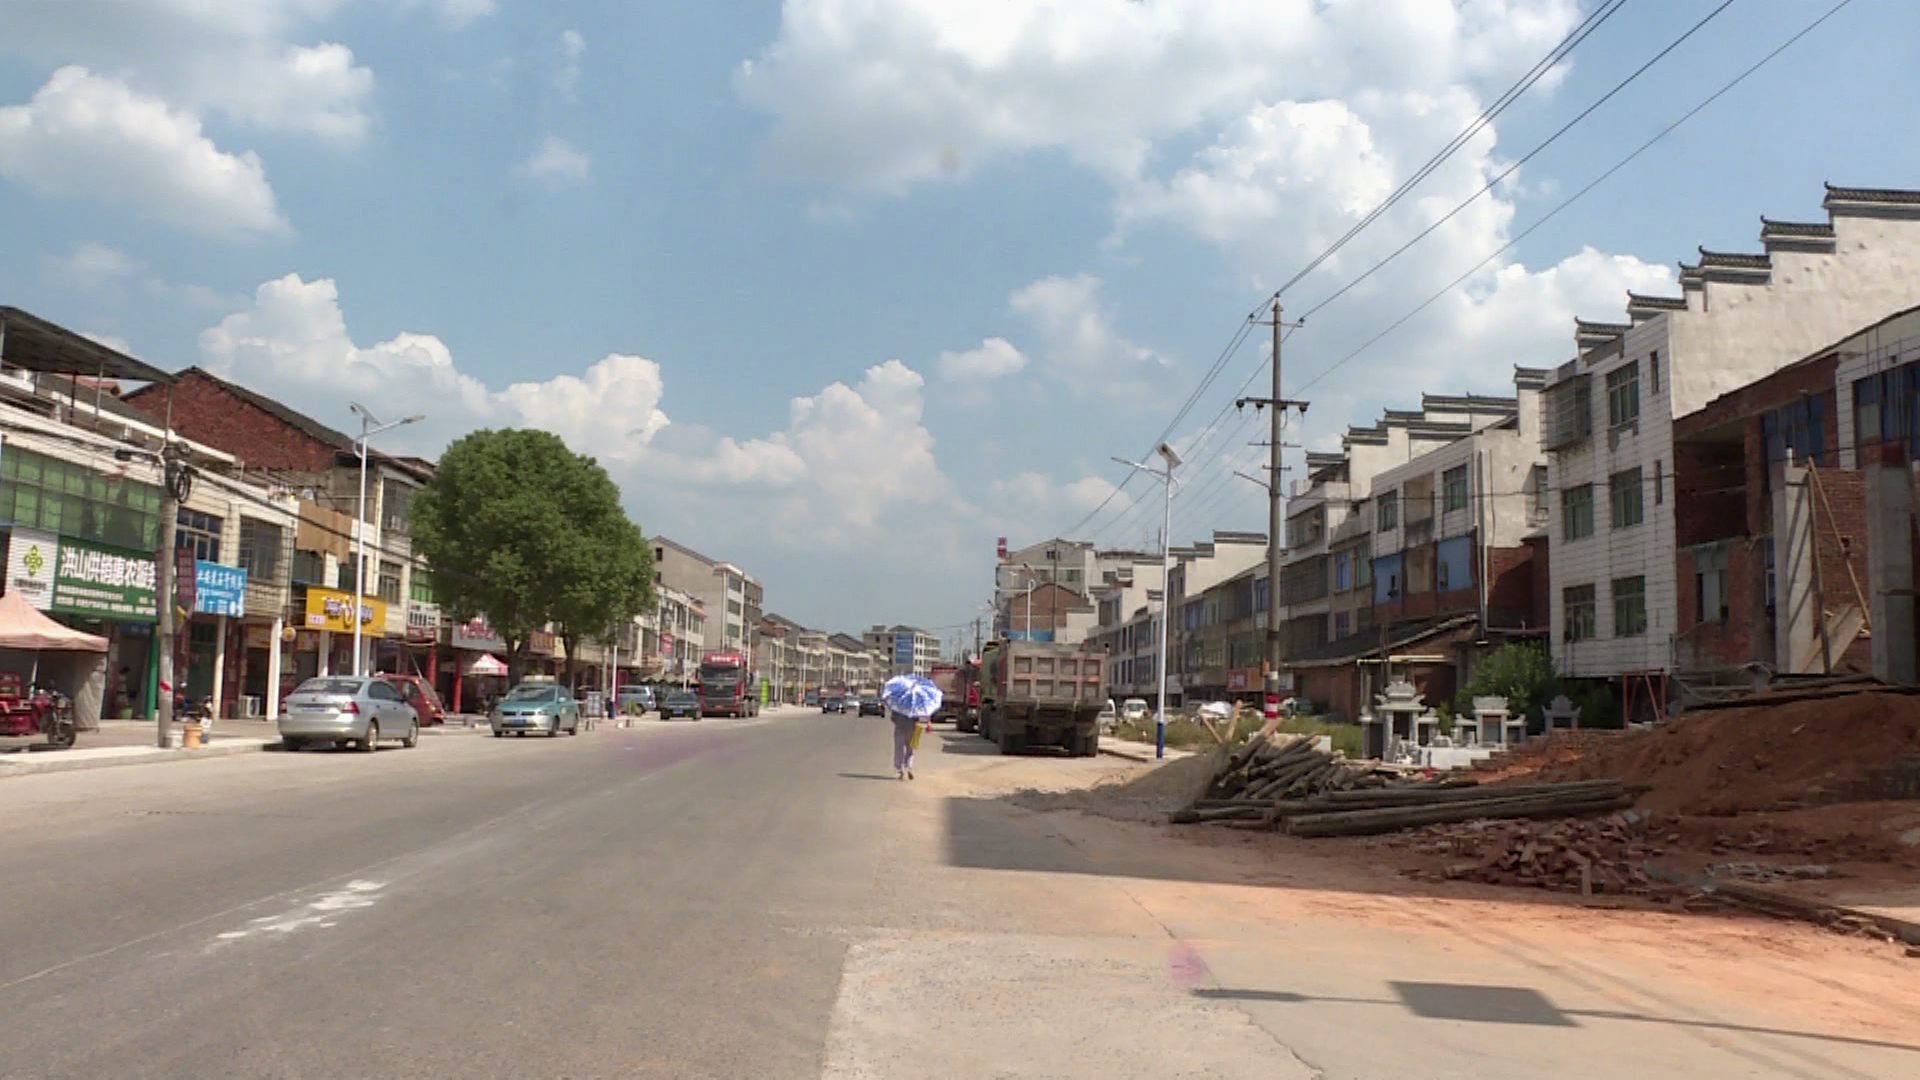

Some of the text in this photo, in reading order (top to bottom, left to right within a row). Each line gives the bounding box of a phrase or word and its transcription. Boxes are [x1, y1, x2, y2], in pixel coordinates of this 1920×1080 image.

[60, 547, 177, 593] 洪山供销惠农服务
